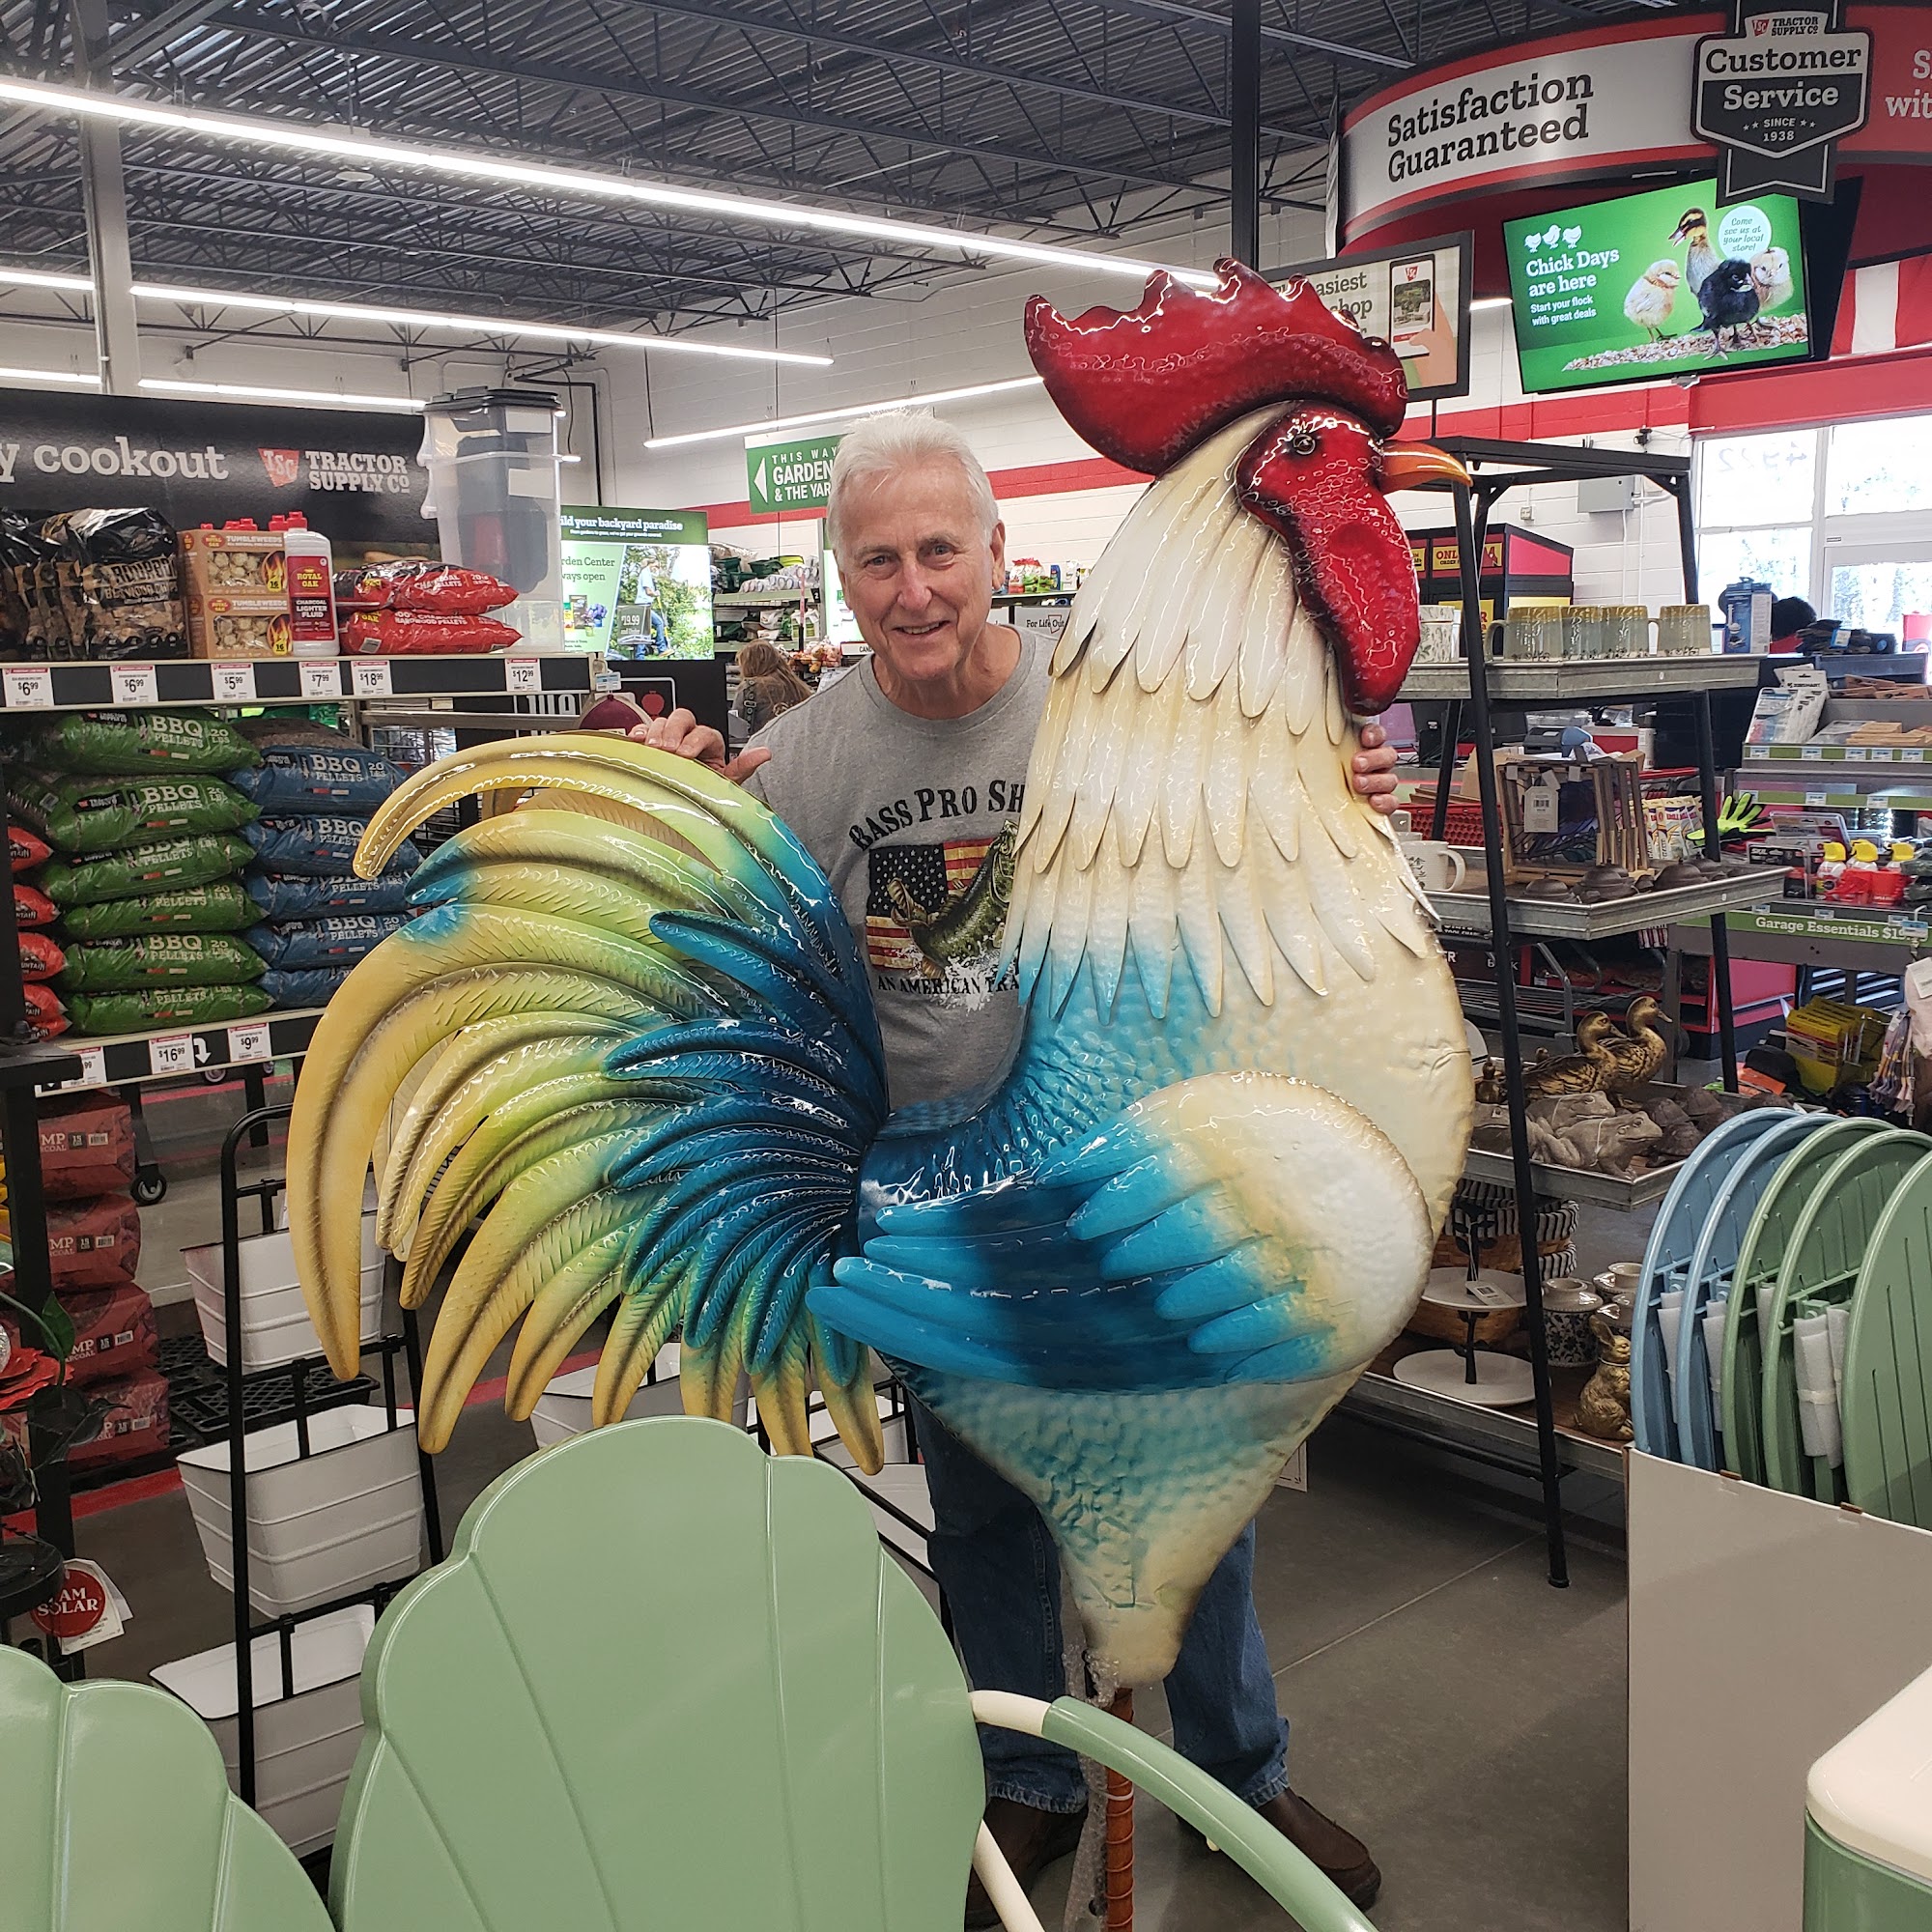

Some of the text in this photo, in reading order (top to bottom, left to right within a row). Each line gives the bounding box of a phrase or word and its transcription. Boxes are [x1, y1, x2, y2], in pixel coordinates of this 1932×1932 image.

[1772, 16, 1819, 27] TRACTOR
[1772, 26, 1806, 37] SUPPLY
[1706, 48, 1862, 73] Customer
[1913, 49, 1932, 80] S
[1723, 81, 1839, 110] Service
[1387, 72, 1594, 148] Satisfaction
[1764, 118, 1796, 128] SINCE
[1388, 102, 1589, 183] Guaranteed
[1763, 130, 1795, 142] 1938
[1723, 237, 1742, 245] your
[1526, 248, 1620, 277] Chick Days
[1528, 274, 1597, 298] are here
[1530, 295, 1593, 314] Start your flock
[1532, 307, 1597, 326] with great deals
[34, 436, 229, 480] cookout
[263, 450, 295, 479] TSC
[305, 451, 408, 474] TRACTOR
[772, 446, 838, 465] THIS WAY
[308, 470, 384, 493] SUPPLY
[773, 460, 834, 485] GARDEN
[774, 488, 783, 502] &
[785, 485, 809, 500] THE
[575, 518, 598, 529] your
[599, 517, 642, 531] backyard
[642, 520, 684, 532] paradise
[583, 556, 615, 567] Center
[583, 574, 606, 583] open
[1026, 619, 1037, 628] For
[1039, 619, 1051, 628] Life
[152, 716, 228, 739] BBQ 20
[155, 731, 204, 749] PELLETS
[309, 754, 384, 773] BBQ 20
[316, 772, 364, 782] PELLETS
[141, 784, 222, 806] BBQ 20
[148, 800, 203, 814] PELLETS
[316, 818, 365, 837] BBQ
[848, 799, 913, 852] BASS
[914, 785, 978, 822] PRO
[145, 848, 193, 866] PELLETS
[332, 882, 381, 893] PELLETS
[155, 895, 207, 907] PELLETS
[327, 916, 400, 931] BBQ 20
[1755, 917, 1879, 939] Garage Essentials
[150, 935, 202, 952] BBQ
[330, 930, 378, 941] PELLETS
[151, 951, 204, 961] PELLETS
[878, 975, 895, 991] AN
[900, 978, 981, 995] AMERICAN
[156, 992, 207, 1005] PELLETS
[59, 1587, 87, 1603] AM
[37, 1598, 99, 1617] SOLAR
